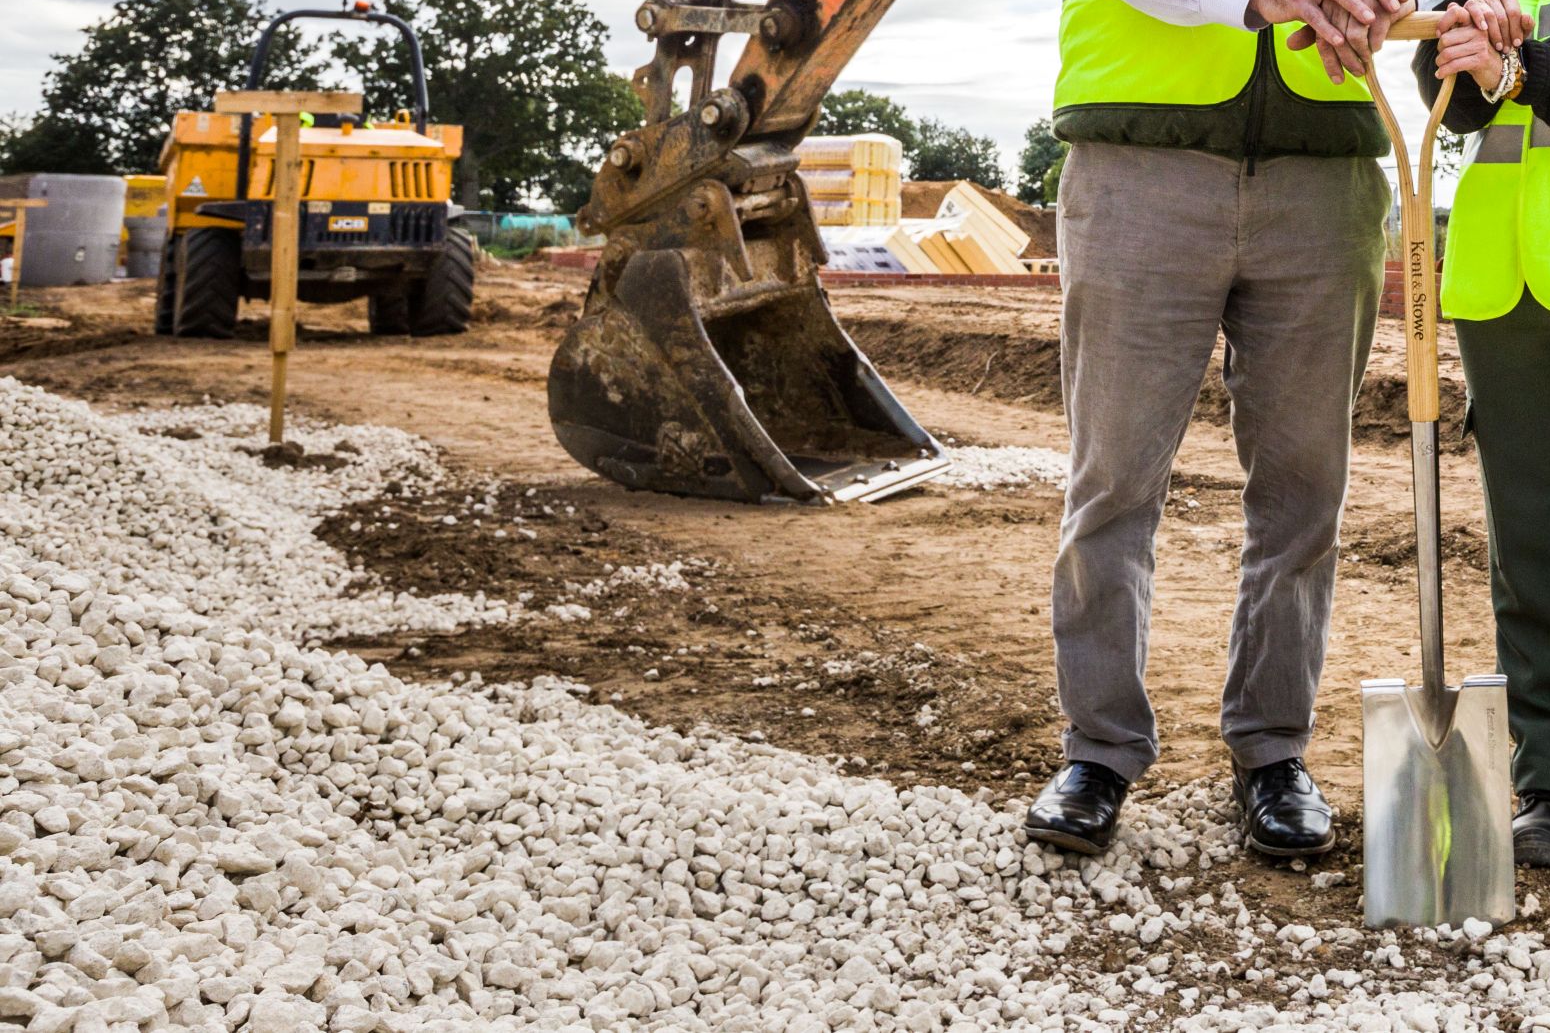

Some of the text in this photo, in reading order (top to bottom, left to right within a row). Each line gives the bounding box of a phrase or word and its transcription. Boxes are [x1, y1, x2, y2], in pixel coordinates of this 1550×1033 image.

[1411, 240, 1427, 341] Kent & Stowe
